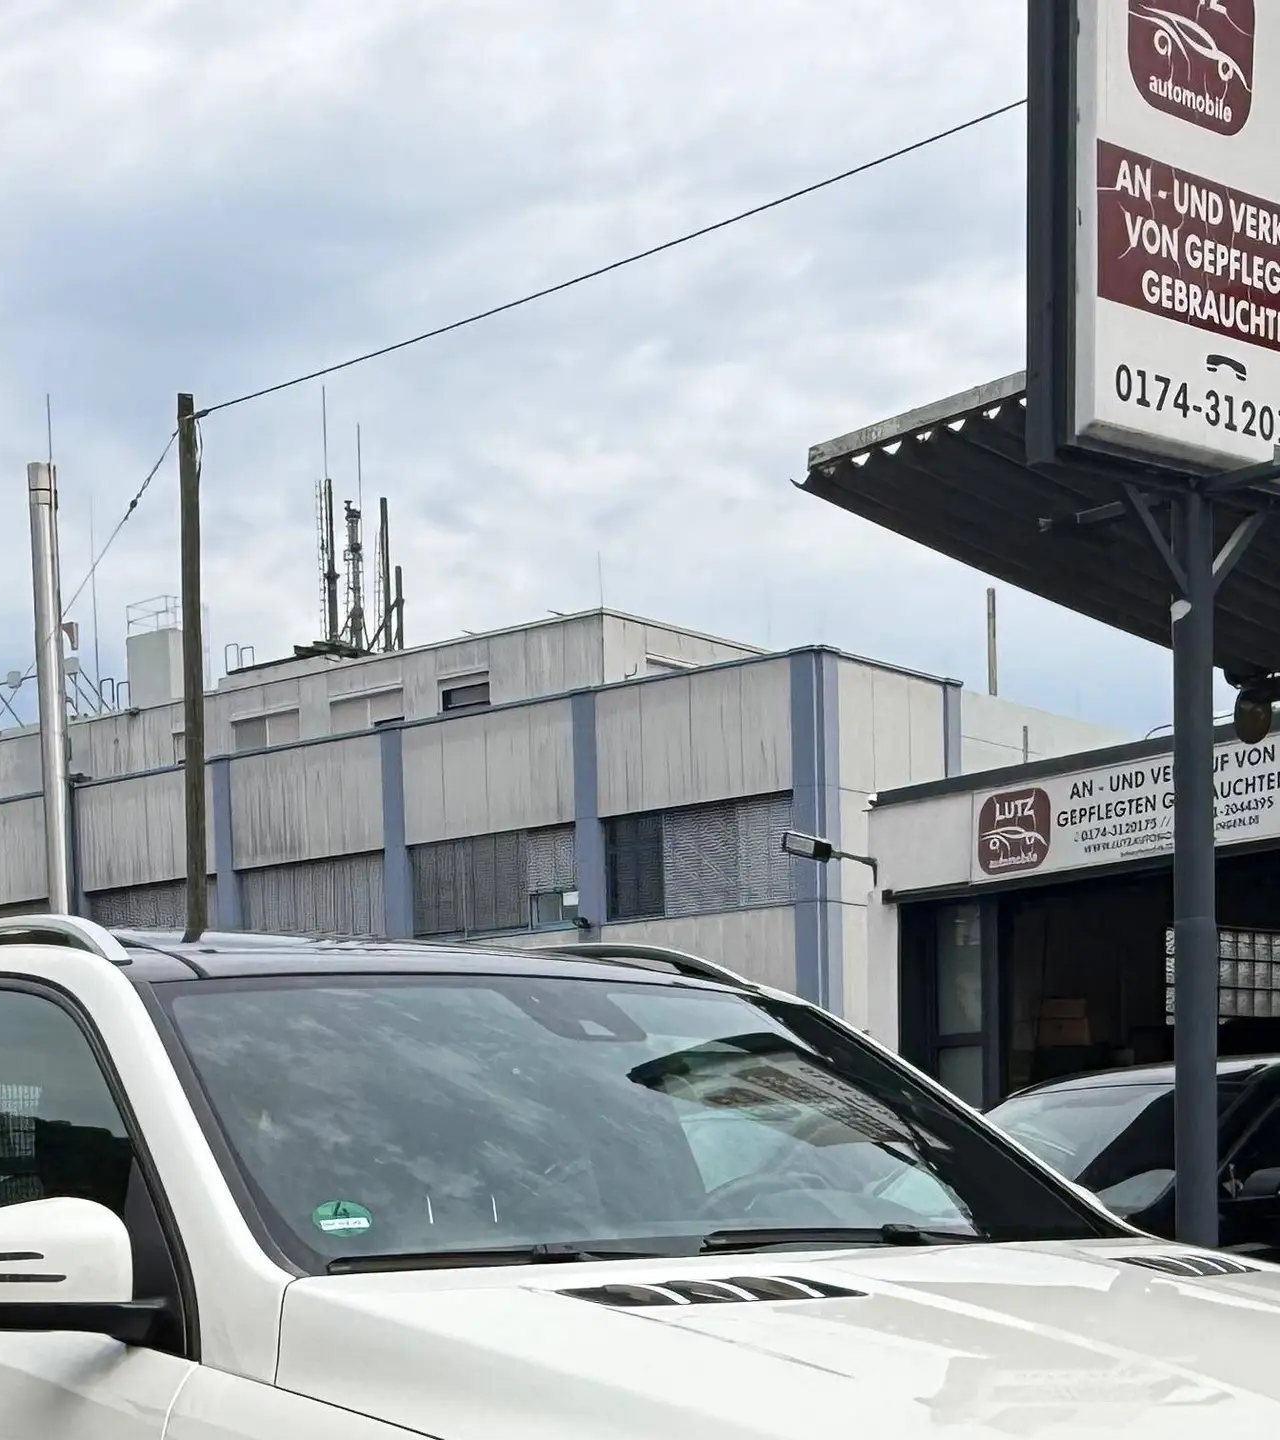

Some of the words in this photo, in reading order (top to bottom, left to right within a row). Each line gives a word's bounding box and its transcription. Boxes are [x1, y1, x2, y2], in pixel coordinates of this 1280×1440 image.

[1149, 74, 1232, 122] automobile
[1116, 160, 1152, 202] AN
[1173, 180, 1224, 226] UND
[1124, 212, 1180, 262] VON
[1070, 779, 1093, 800] AN
[1109, 771, 1145, 792] UND
[1235, 744, 1275, 768] VON
[995, 797, 1035, 821] LUTZ
[1057, 794, 1157, 827] GEPFLEGTEN
